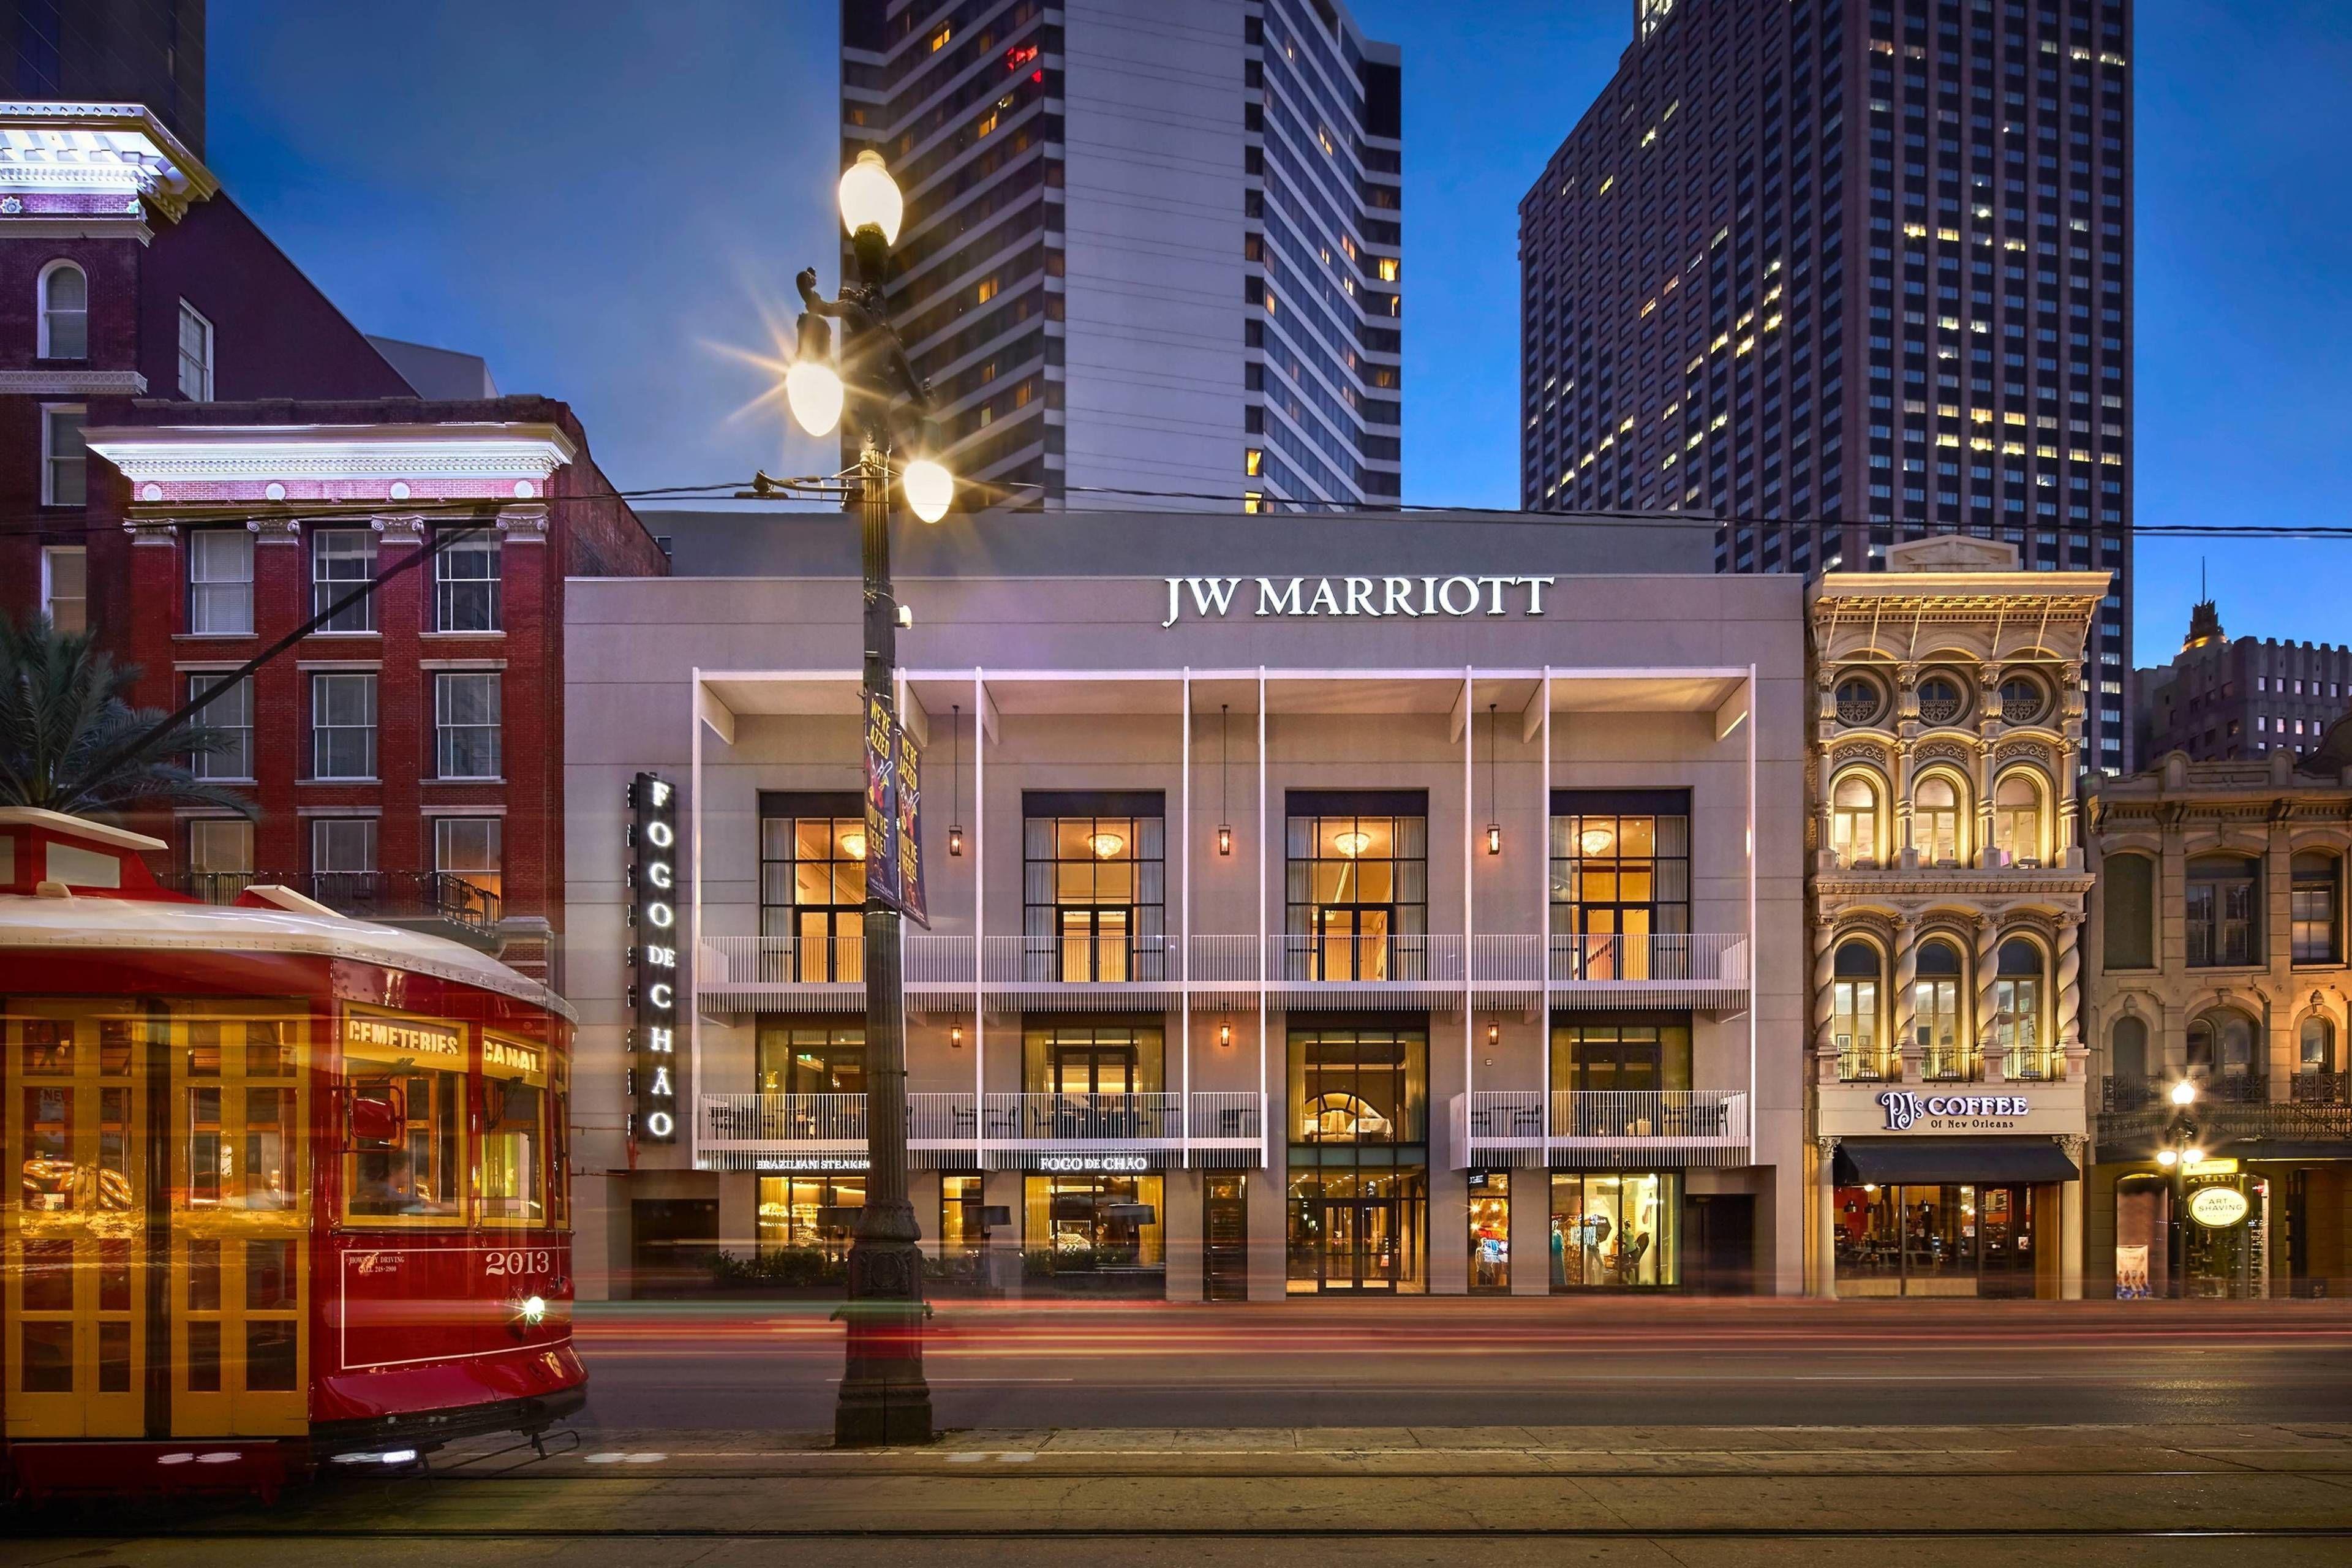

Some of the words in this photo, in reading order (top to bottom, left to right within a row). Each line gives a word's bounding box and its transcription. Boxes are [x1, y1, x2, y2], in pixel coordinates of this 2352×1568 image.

[1162, 578, 1242, 628] JW
[1255, 576, 1555, 617] MARRIOTT
[871, 698, 891, 737] WE'RE
[870, 724, 890, 760] AZZED
[899, 755, 918, 791] JAZZED
[648, 781, 673, 927] FOGO
[647, 945, 676, 968] DE
[349, 1020, 458, 1055] CEMETERIES
[483, 1040, 540, 1072] CANAL
[649, 984, 673, 1136] CHÃO
[1881, 1091, 1924, 1130] PJ's
[1928, 1096, 2029, 1116] COFFEE
[1931, 1120, 1942, 1128] Of
[1948, 1120, 1967, 1128] New
[1972, 1120, 2014, 1128] Orleans
[756, 1159, 818, 1170] BRAZILIAN
[1040, 1158, 1083, 1170] FOGO
[1084, 1159, 1101, 1169] DE
[2198, 1204, 2243, 1212] SHAVING
[486, 1251, 549, 1276] 2013
